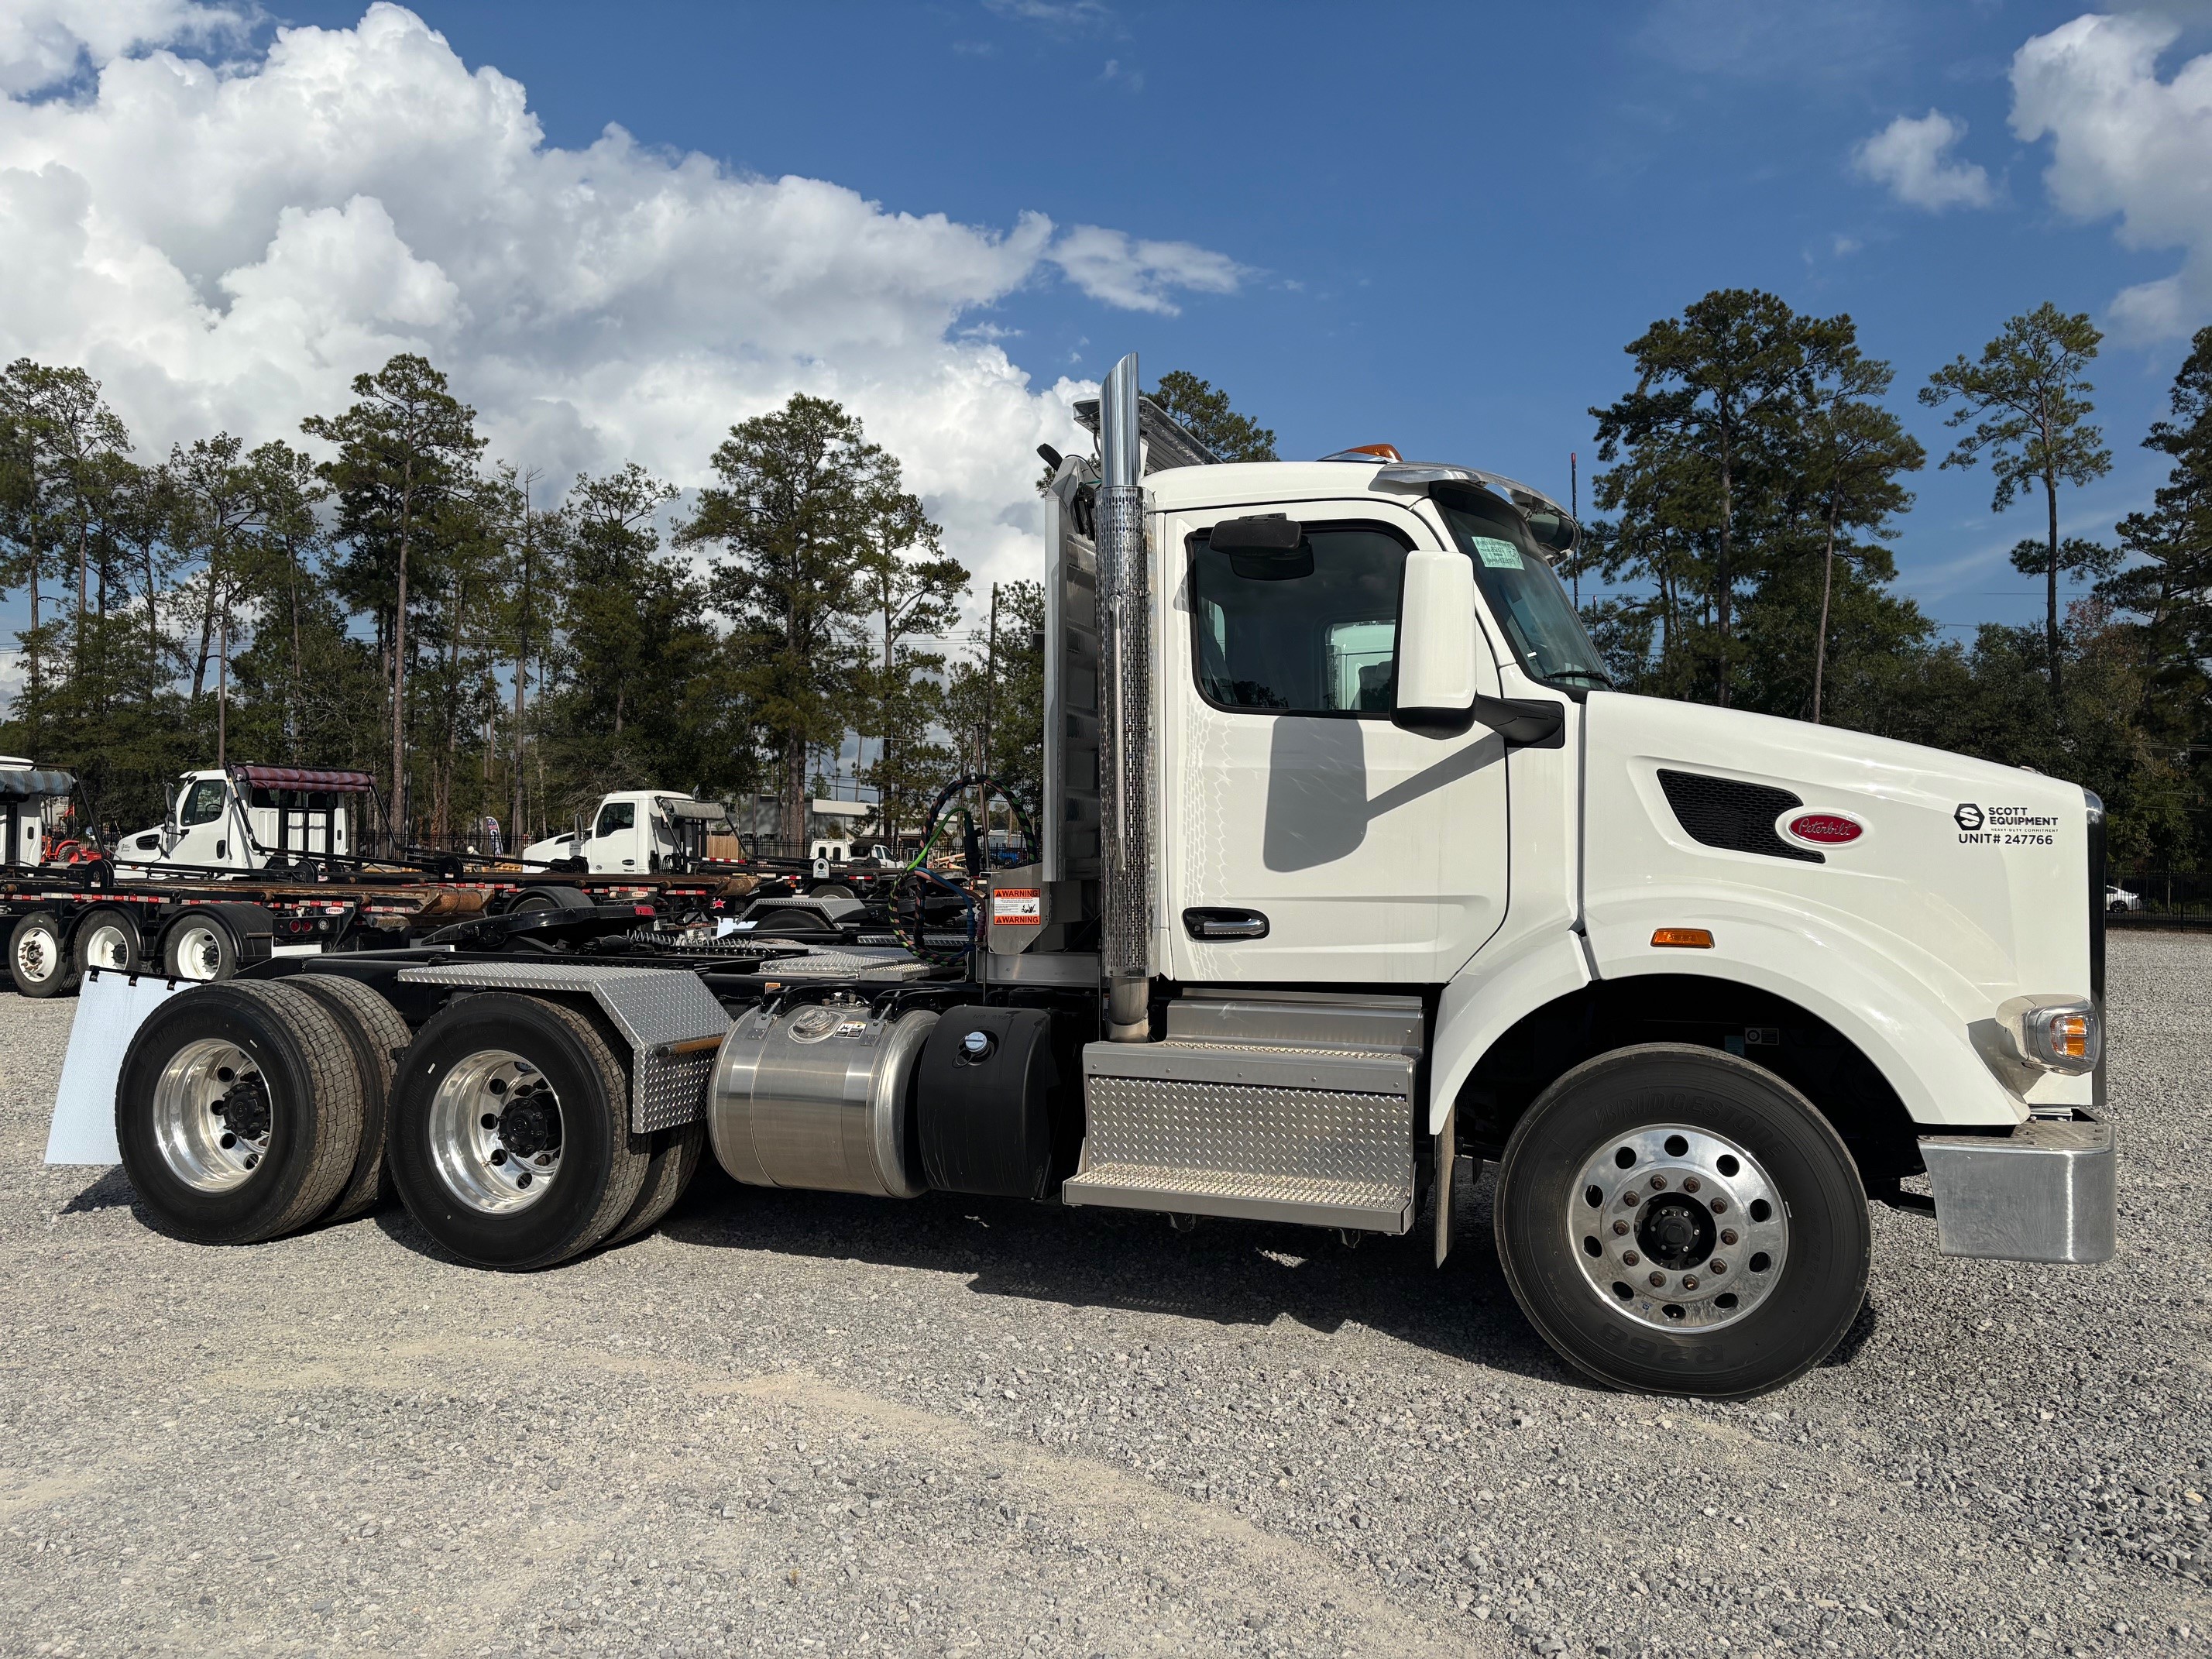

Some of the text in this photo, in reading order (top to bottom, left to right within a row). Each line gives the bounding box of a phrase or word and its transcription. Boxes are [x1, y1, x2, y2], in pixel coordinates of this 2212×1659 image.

[1988, 807, 2028, 816] SCOTT
[1798, 818, 1857, 836] Peterbilt
[1989, 817, 2059, 826] EQUIPMENT
[1959, 833, 2053, 845] UNIT# 247766
[1594, 1091, 1790, 1157] BRIDGESTONE
